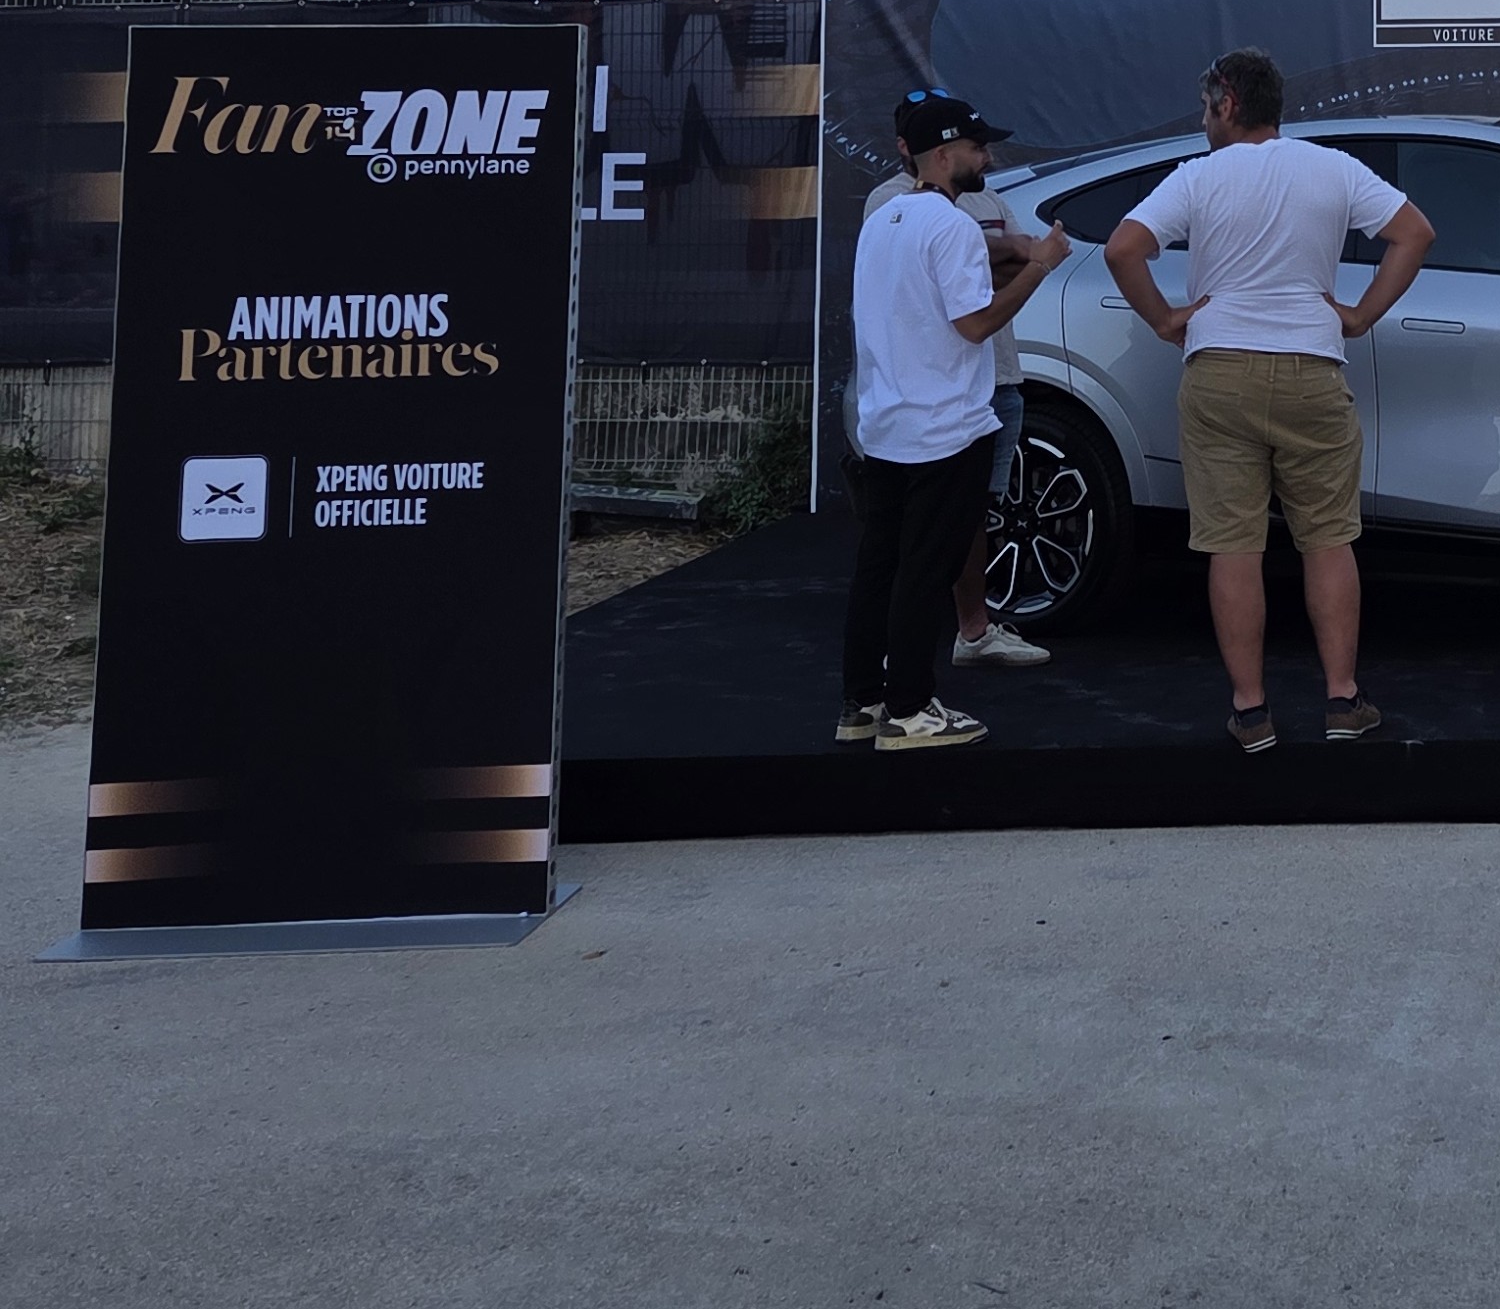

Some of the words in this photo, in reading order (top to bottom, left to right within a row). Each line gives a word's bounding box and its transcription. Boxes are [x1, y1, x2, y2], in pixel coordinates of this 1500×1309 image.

[1433, 27, 1495, 42] VOITURE
[147, 75, 322, 156] Fan
[323, 106, 359, 117] TOP
[346, 88, 550, 156] ZONE
[324, 126, 356, 142] 14
[404, 155, 530, 180] pennylane
[227, 293, 449, 340] ANIMATIONS
[178, 328, 500, 382] Partenaires
[315, 464, 388, 493] XPENG
[394, 461, 484, 490] VOITURE
[191, 505, 256, 516] XPENG
[314, 497, 427, 528] OFFICIELLE
